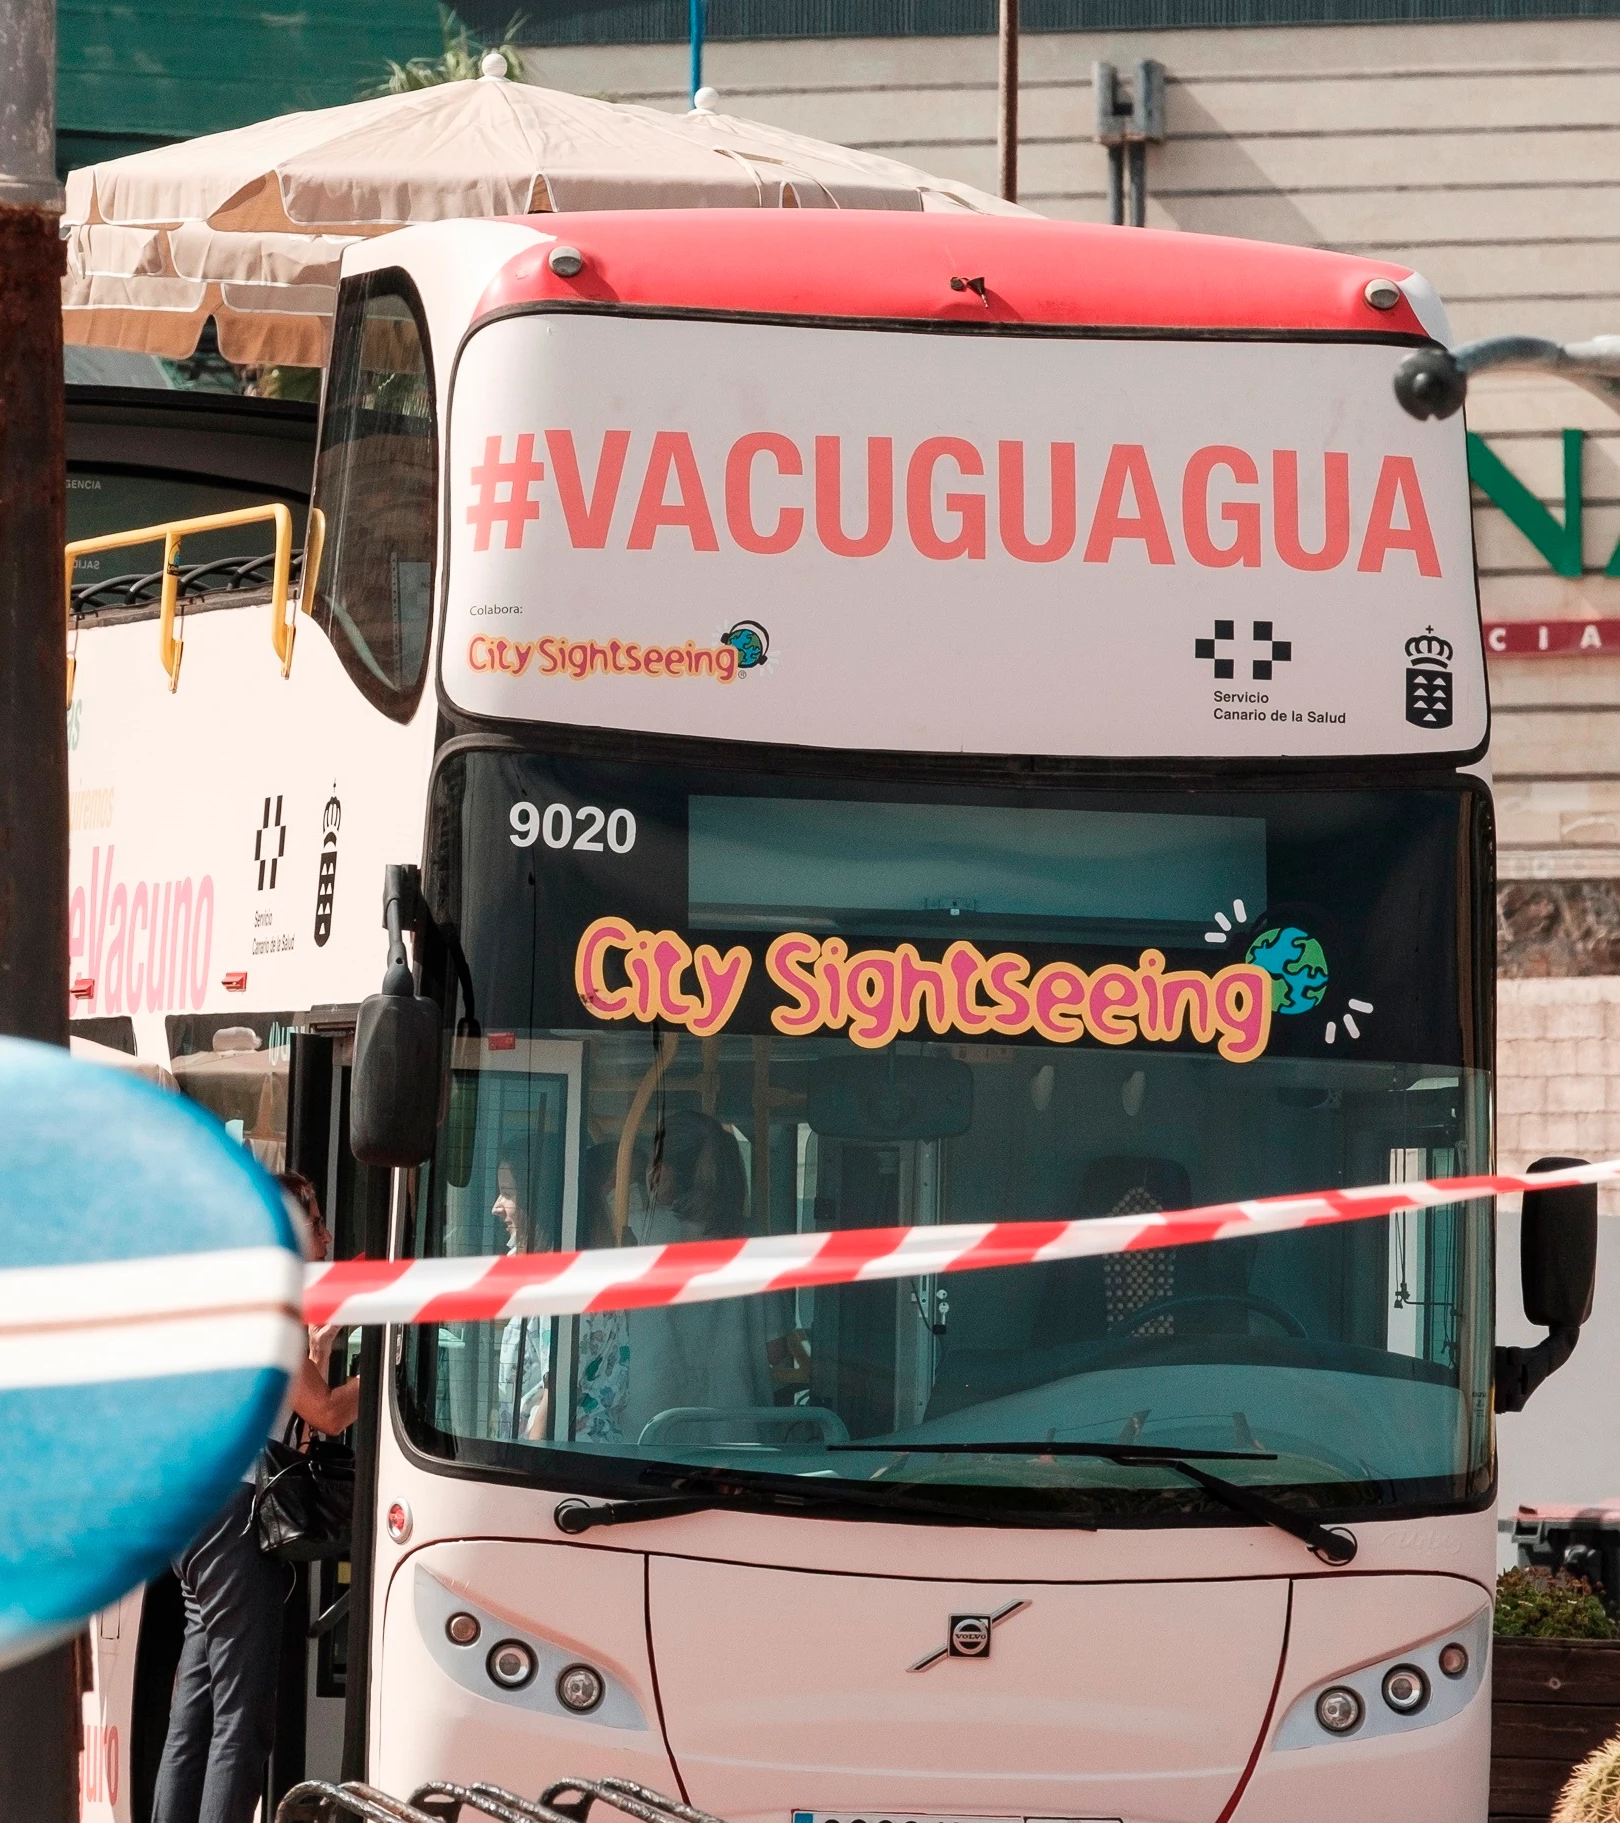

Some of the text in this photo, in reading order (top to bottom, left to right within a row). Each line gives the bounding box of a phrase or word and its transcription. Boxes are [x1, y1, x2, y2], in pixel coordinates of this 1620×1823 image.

[466, 429, 1443, 577] #VACUGUAGUA
[469, 604, 524, 617] Colabora:
[466, 632, 738, 685] City Sightseeing
[1213, 690, 1270, 704] Servicio
[1213, 707, 1347, 724] Canario de la Salud
[508, 801, 637, 854] 9020
[575, 916, 1272, 1064] City Sightseeing
